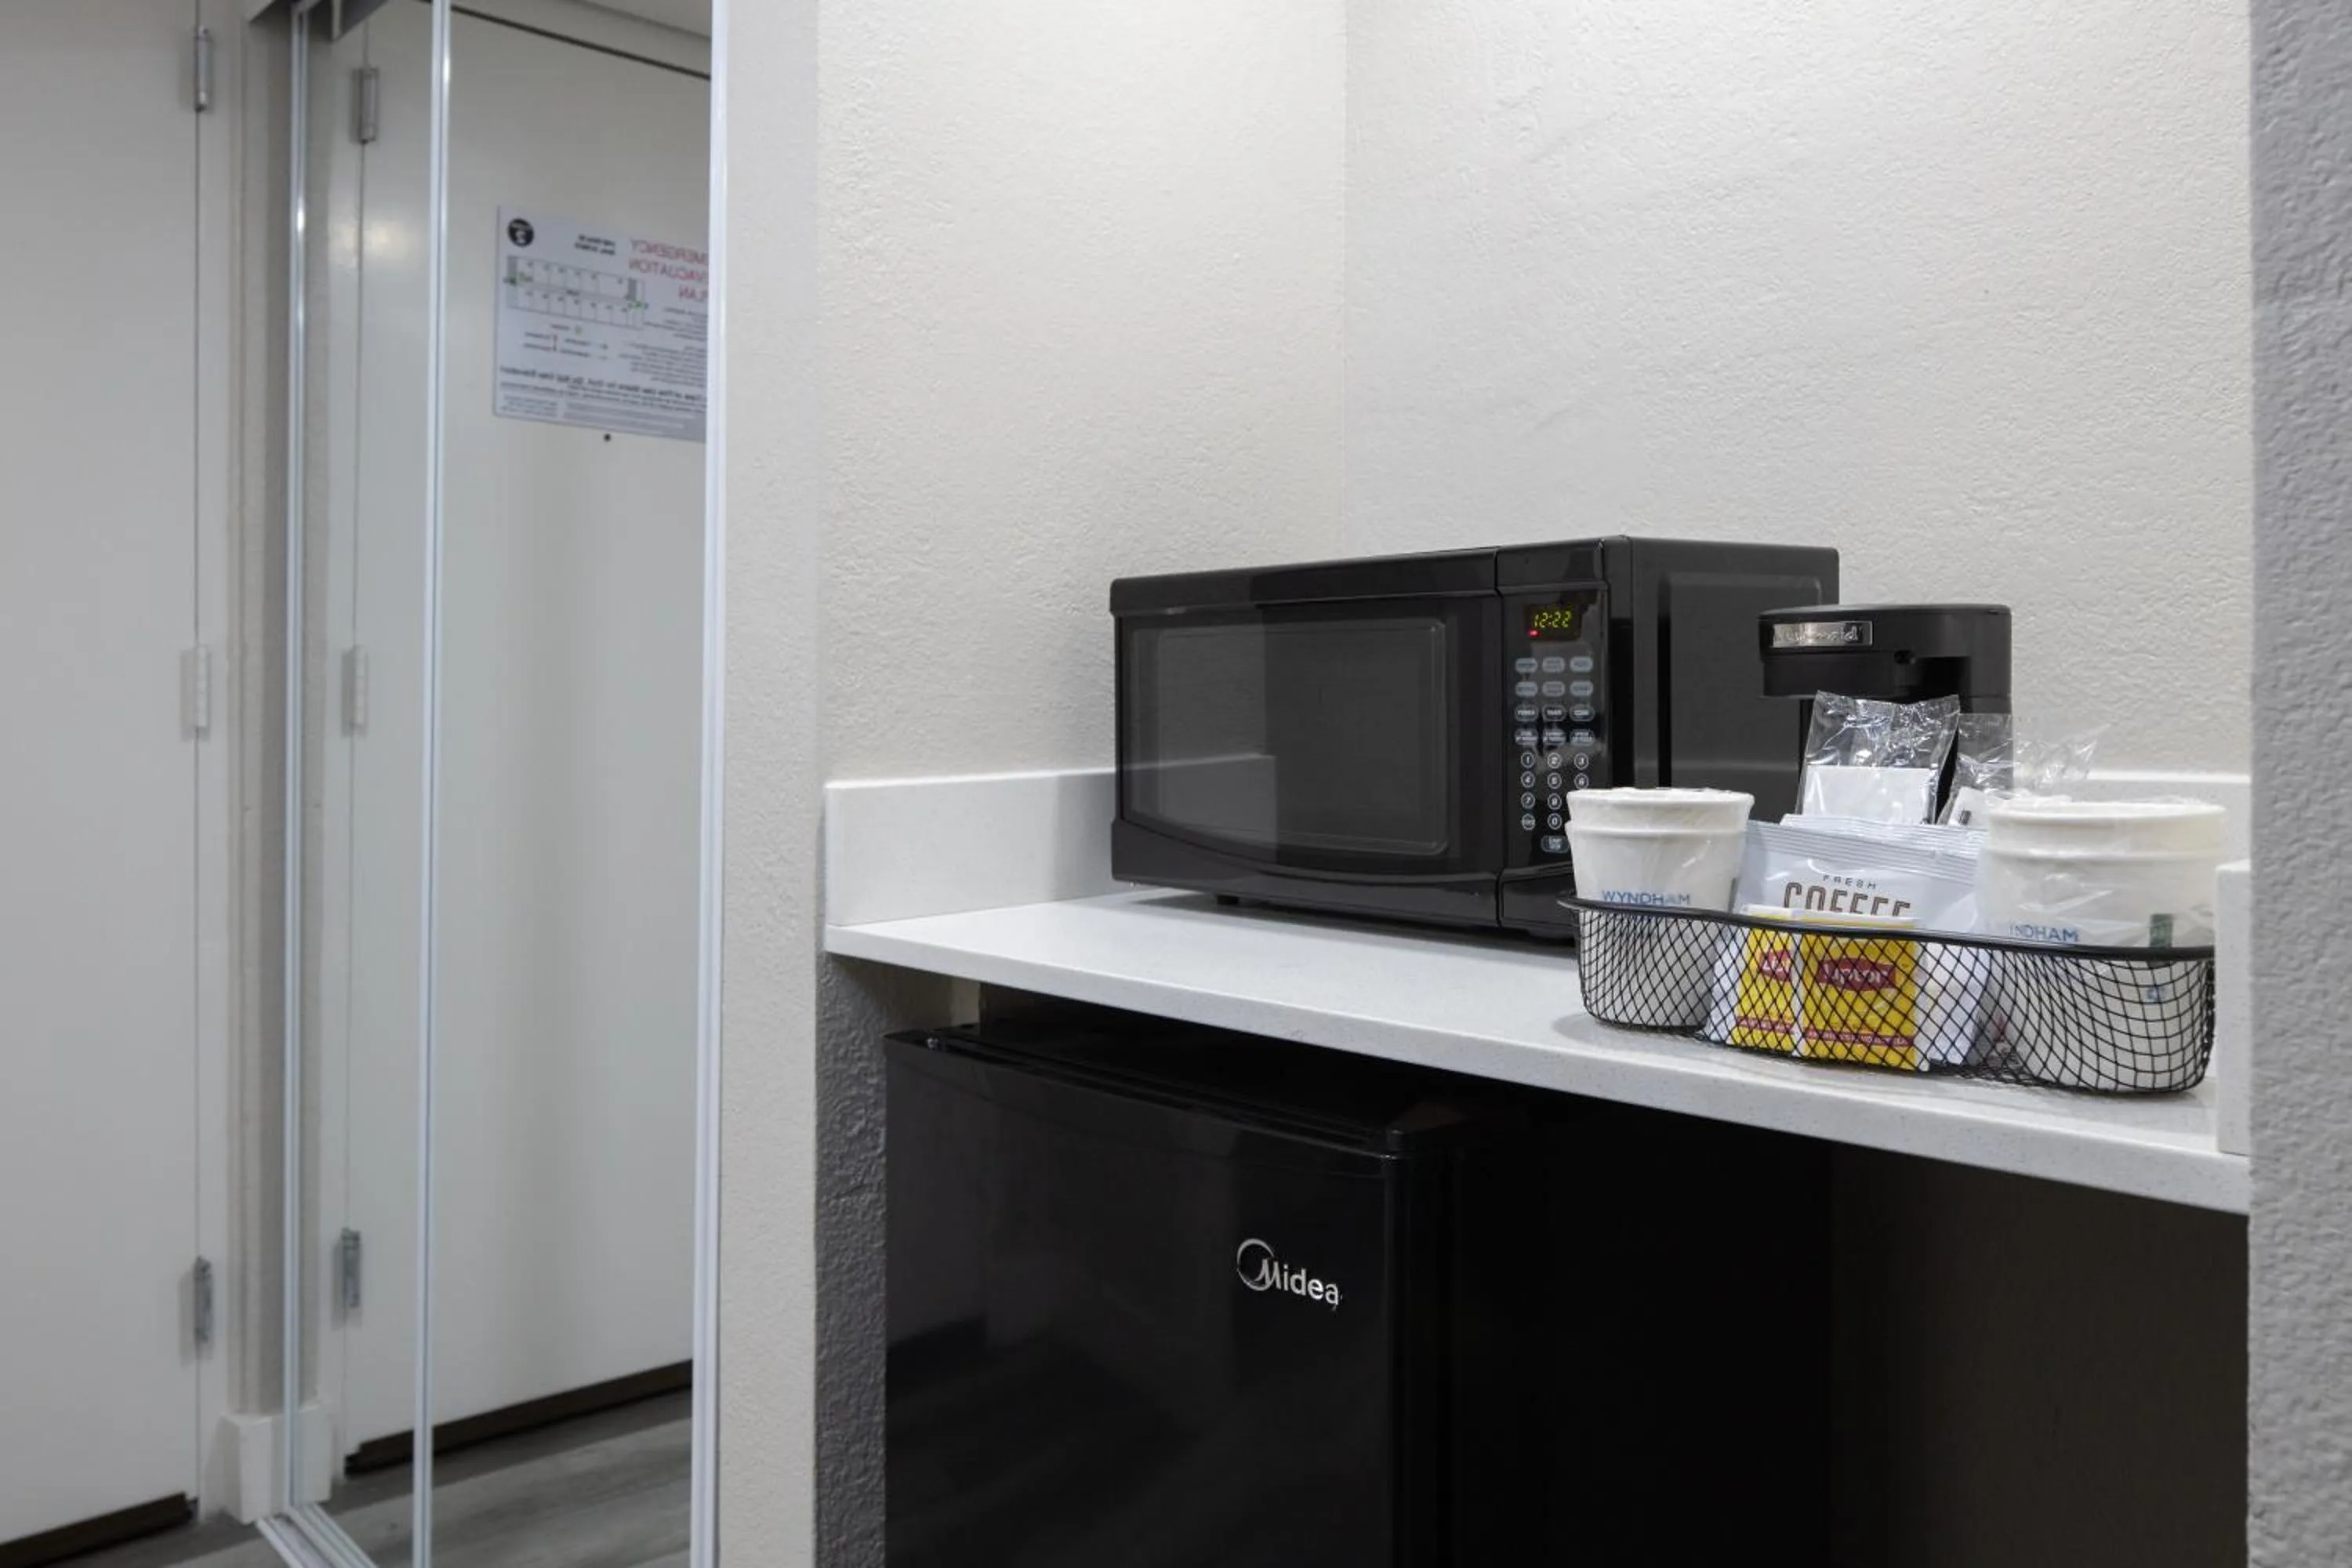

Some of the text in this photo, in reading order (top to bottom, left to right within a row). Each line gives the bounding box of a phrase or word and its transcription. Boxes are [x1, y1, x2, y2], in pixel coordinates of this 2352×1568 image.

[1530, 611, 1572, 628] 12:22
[1822, 873, 1877, 890] FRESH
[1601, 889, 1691, 906] WYNDHAM
[1253, 1257, 1339, 1306] Midea
